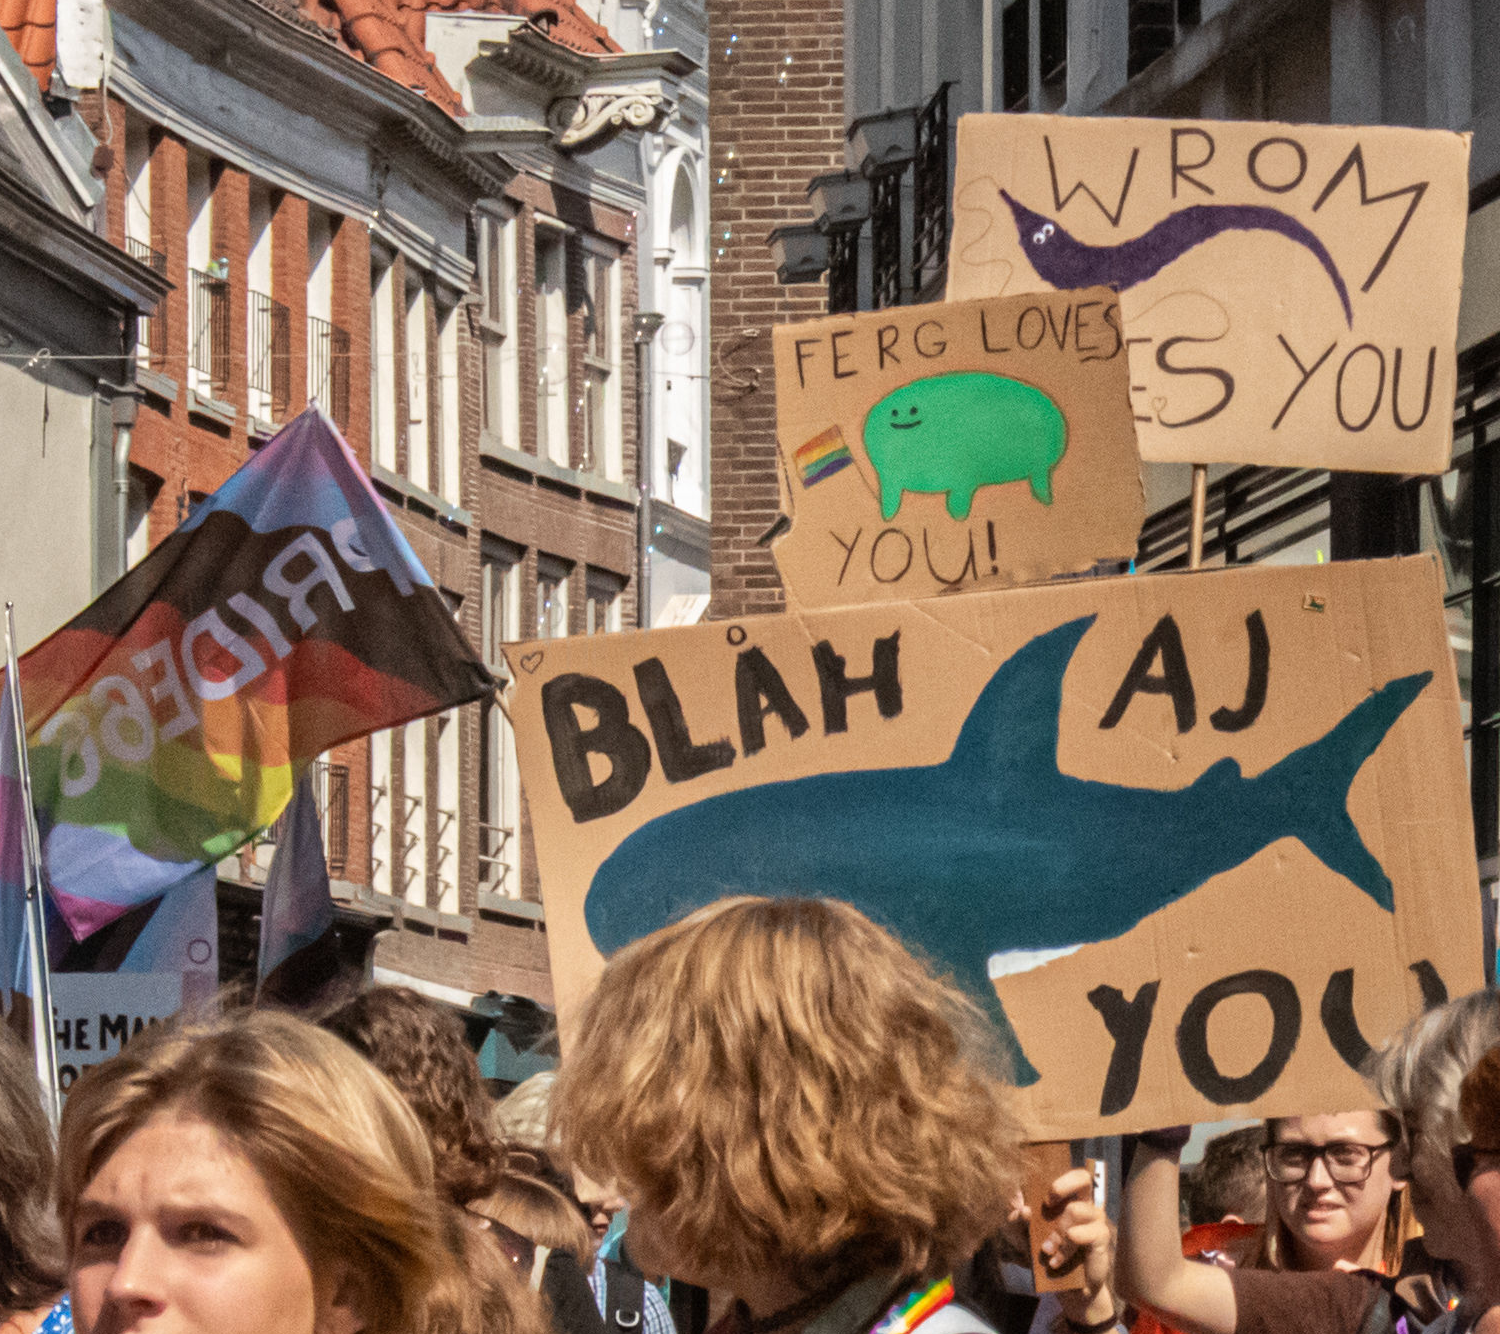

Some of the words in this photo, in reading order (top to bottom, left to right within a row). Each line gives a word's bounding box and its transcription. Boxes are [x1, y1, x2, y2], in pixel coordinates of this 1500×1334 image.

[1043, 127, 1430, 294] WROM
[795, 319, 948, 390] FERG
[980, 301, 1124, 364] LOVES
[1271, 333, 1438, 432] YOU
[828, 520, 1000, 587] YOU!
[1086, 958, 1449, 1117] YOU
